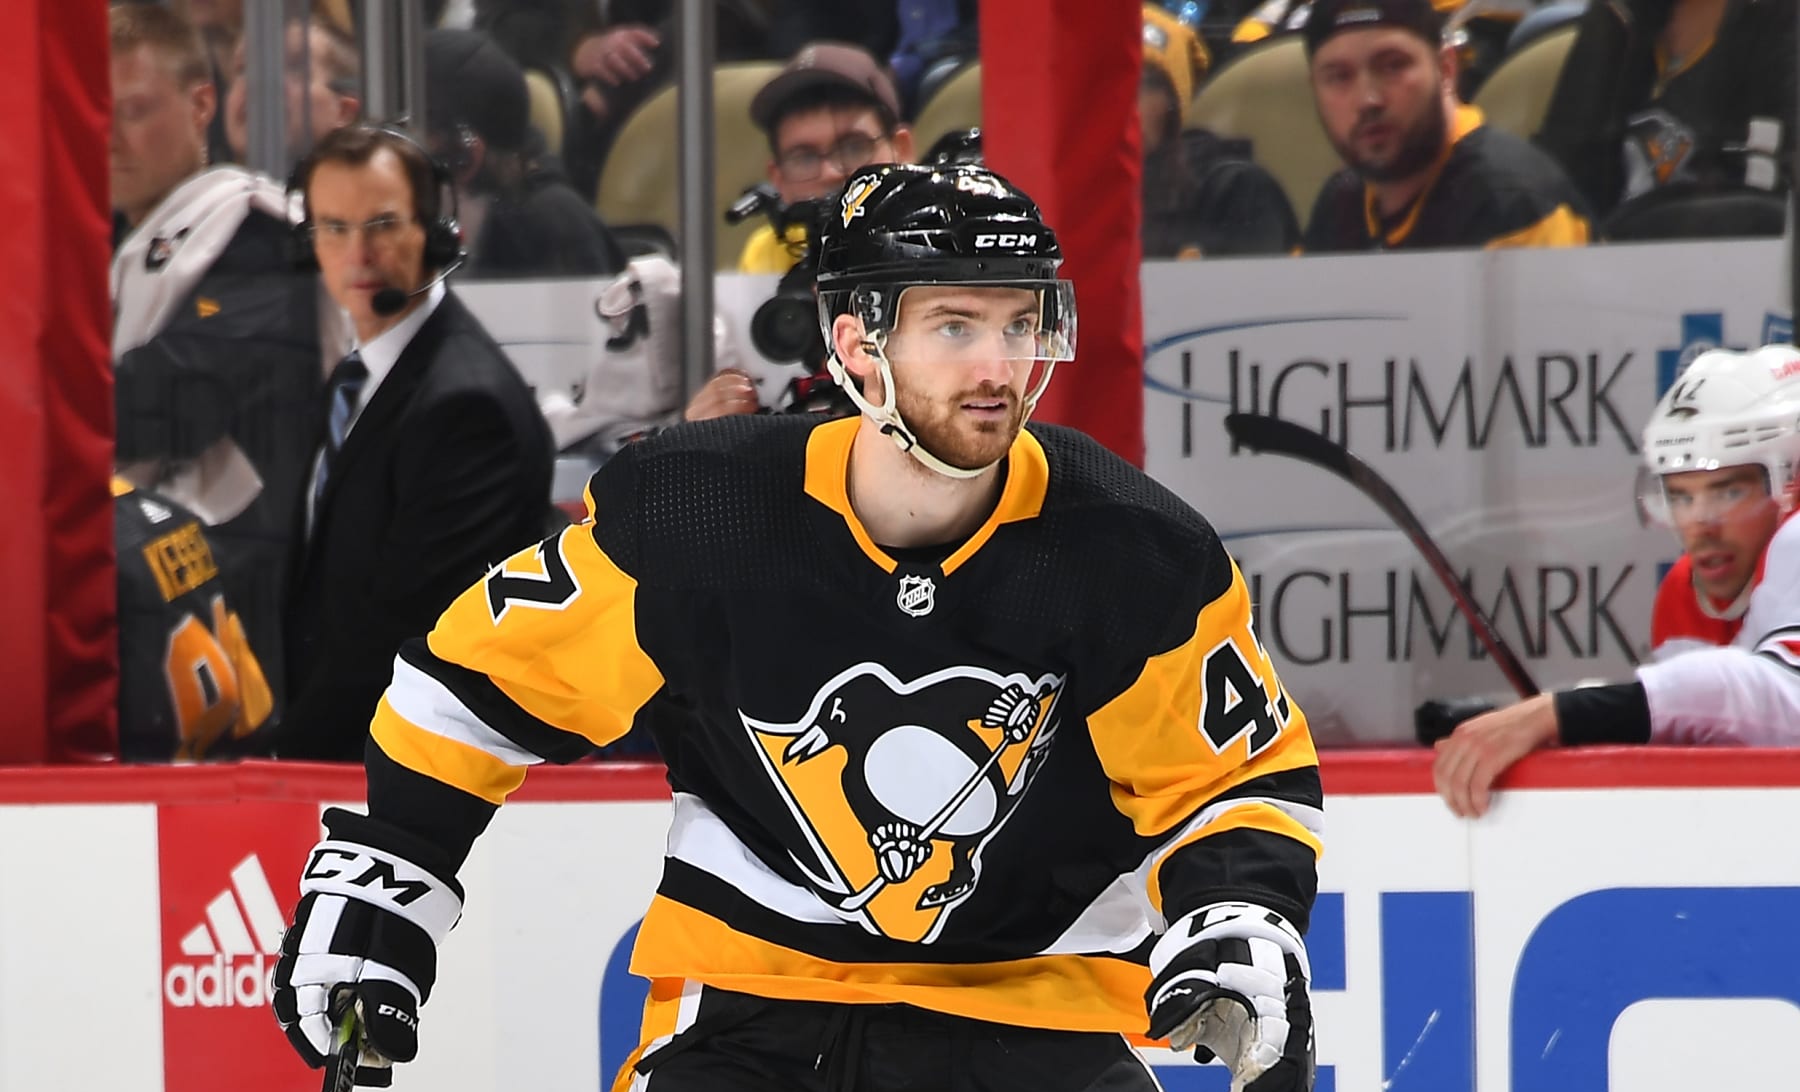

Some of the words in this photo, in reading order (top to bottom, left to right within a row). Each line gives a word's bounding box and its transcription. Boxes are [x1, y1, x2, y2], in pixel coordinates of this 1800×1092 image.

[975, 234, 1037, 248] CCM
[1181, 349, 1641, 457] HIGHMARK
[1234, 555, 1641, 666] IGHMARK
[1198, 618, 1293, 760] 4
[164, 953, 276, 1007] adid
